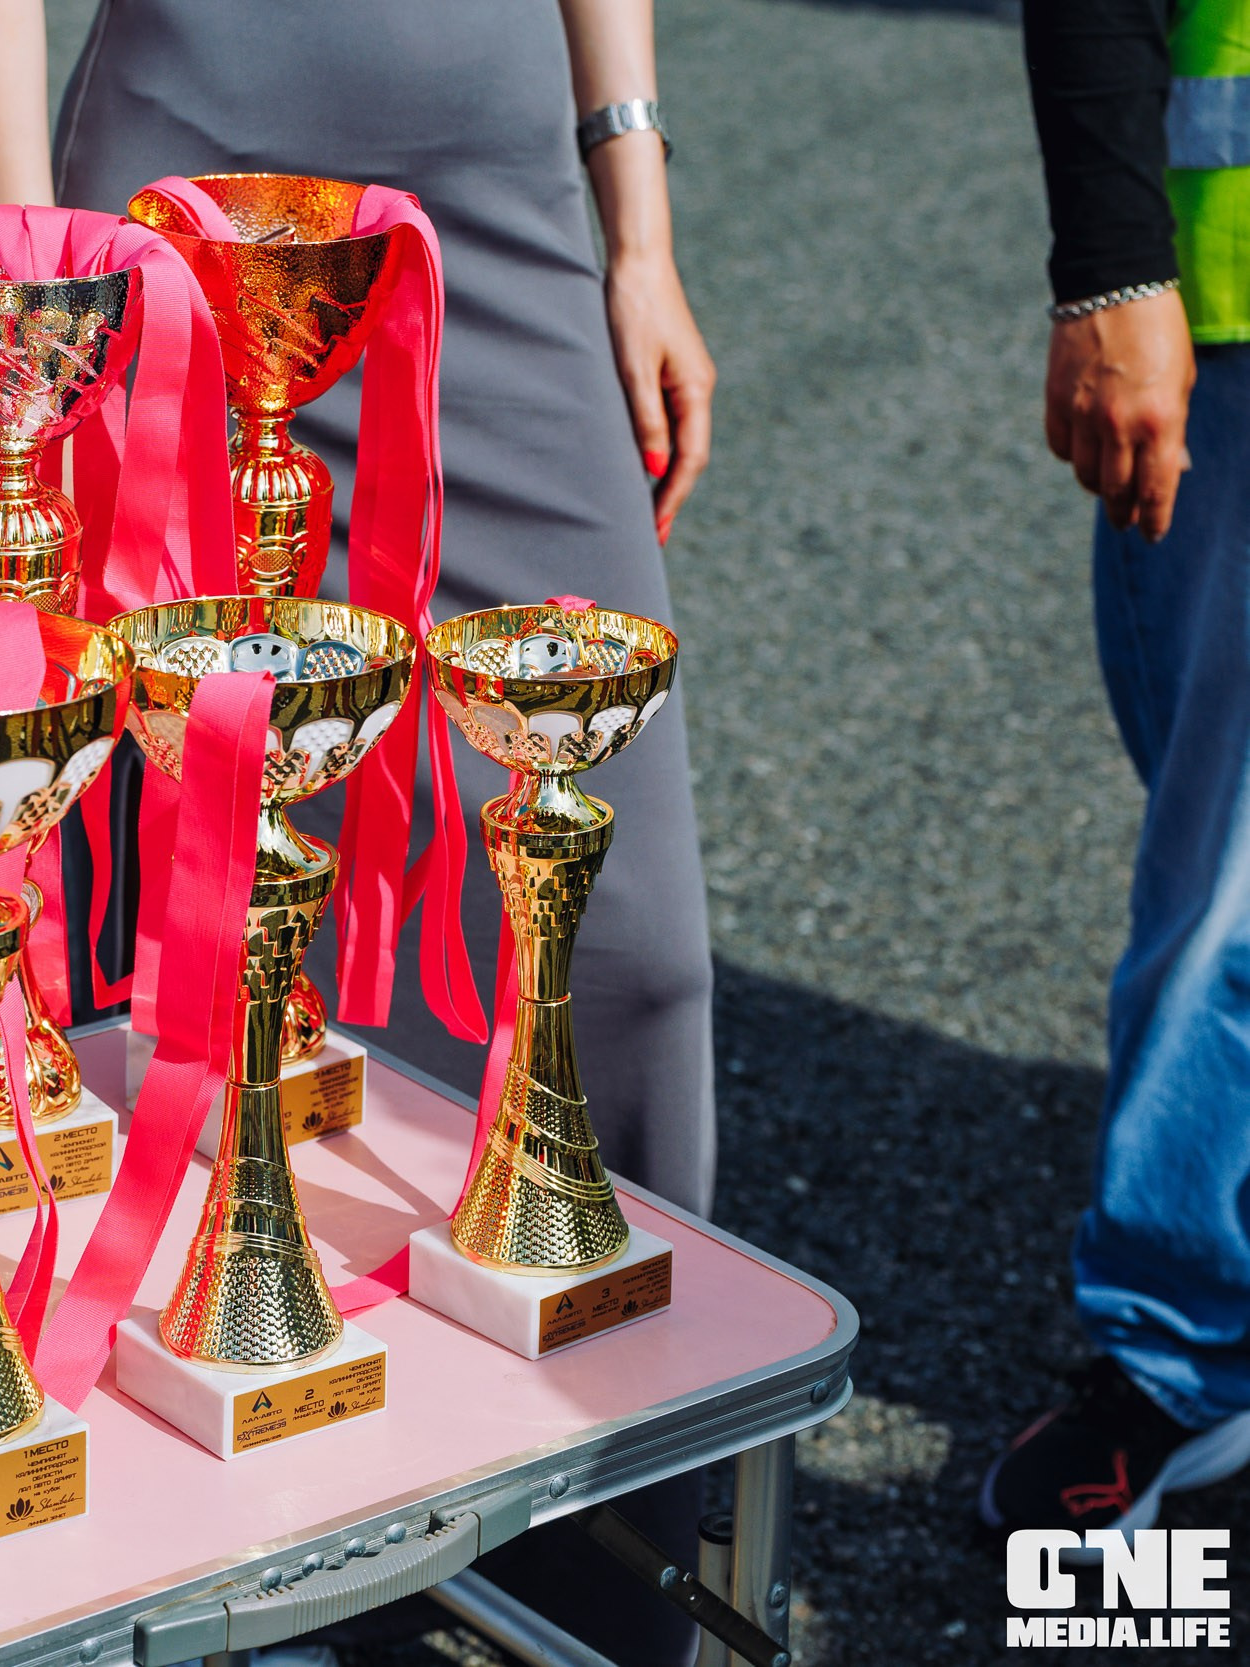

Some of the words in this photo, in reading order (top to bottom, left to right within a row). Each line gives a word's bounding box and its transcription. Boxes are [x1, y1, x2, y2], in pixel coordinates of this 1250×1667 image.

[53, 1134, 61, 1142] 2
[62, 1126, 98, 1140] МЕСТО
[601, 1287, 610, 1299] 3
[592, 1297, 619, 1313] МЕСТО
[304, 1388, 315, 1401] 2
[294, 1399, 325, 1415] МЕСТО
[23, 1450, 28, 1459] 1
[29, 1439, 69, 1458] МЕСТО
[32, 1469, 63, 1482] ОБЛАСТИ
[33, 1479, 52, 1490] АВТО
